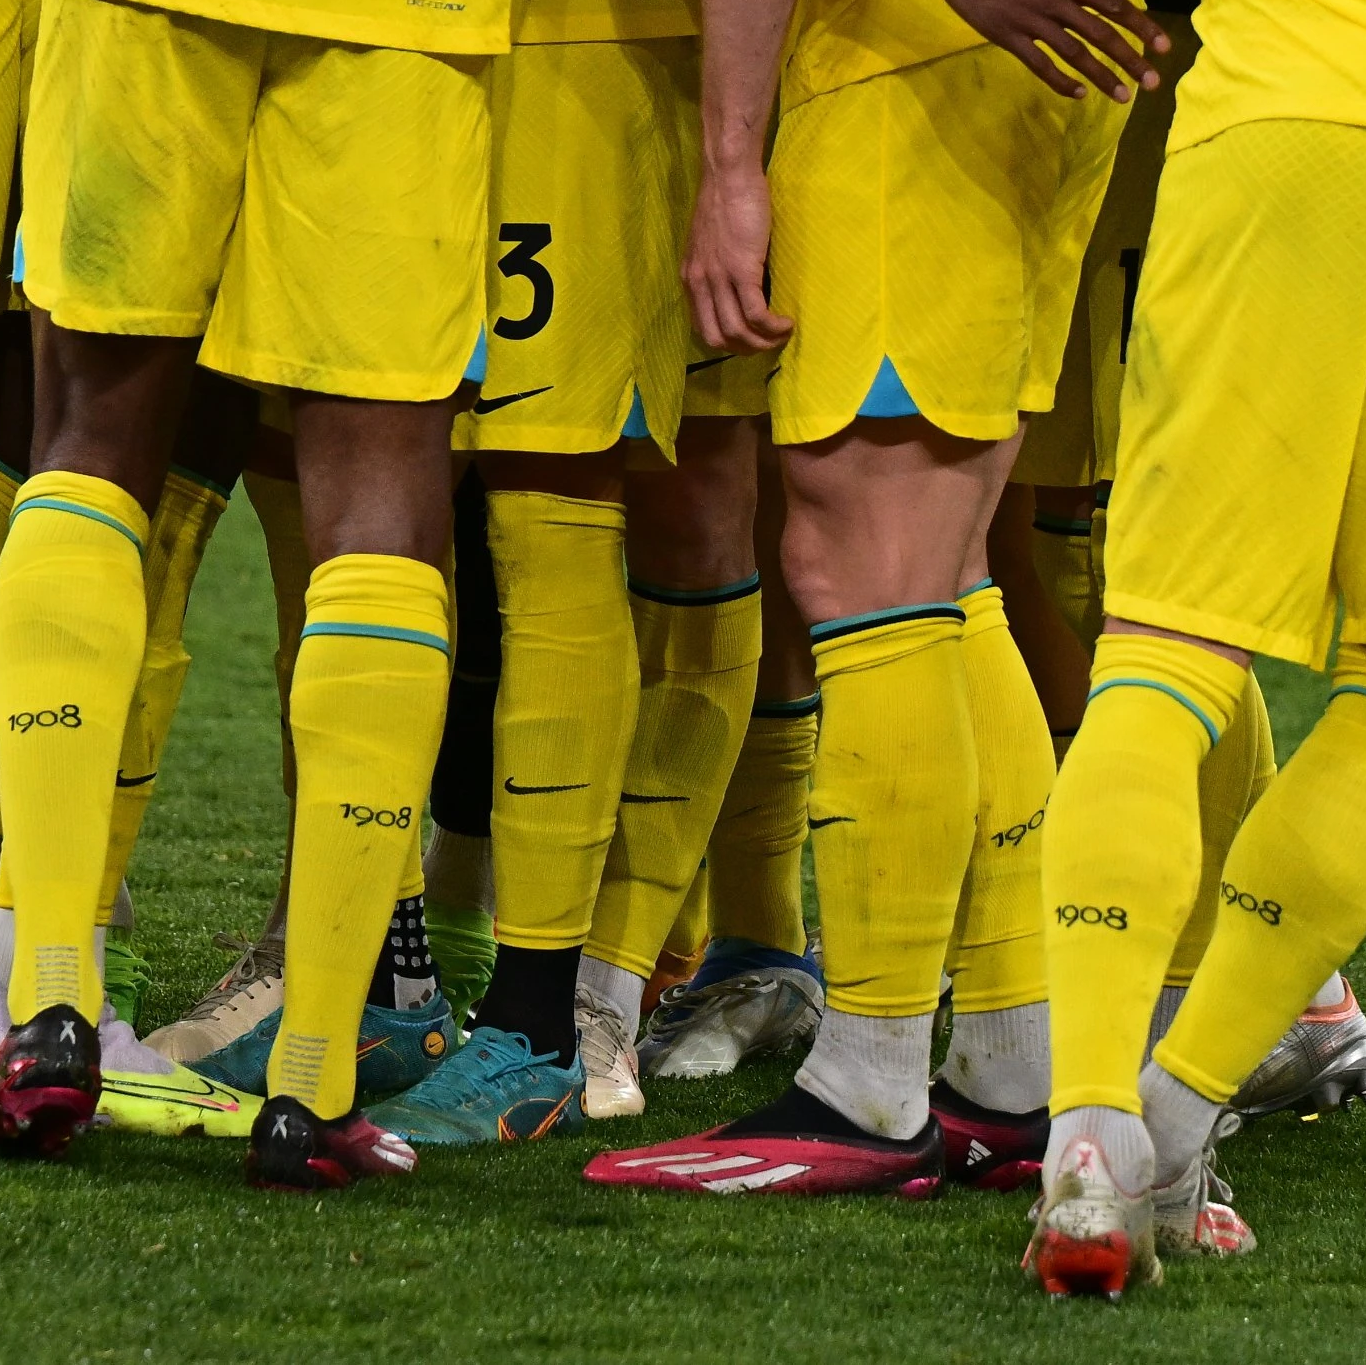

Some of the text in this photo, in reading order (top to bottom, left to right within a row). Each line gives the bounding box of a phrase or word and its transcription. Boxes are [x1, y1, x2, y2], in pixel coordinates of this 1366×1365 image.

[8, 704, 83, 734] 1908
[339, 803, 412, 829] 1908
[1055, 904, 1128, 931] 1908
[1220, 881, 1284, 927] 1908
